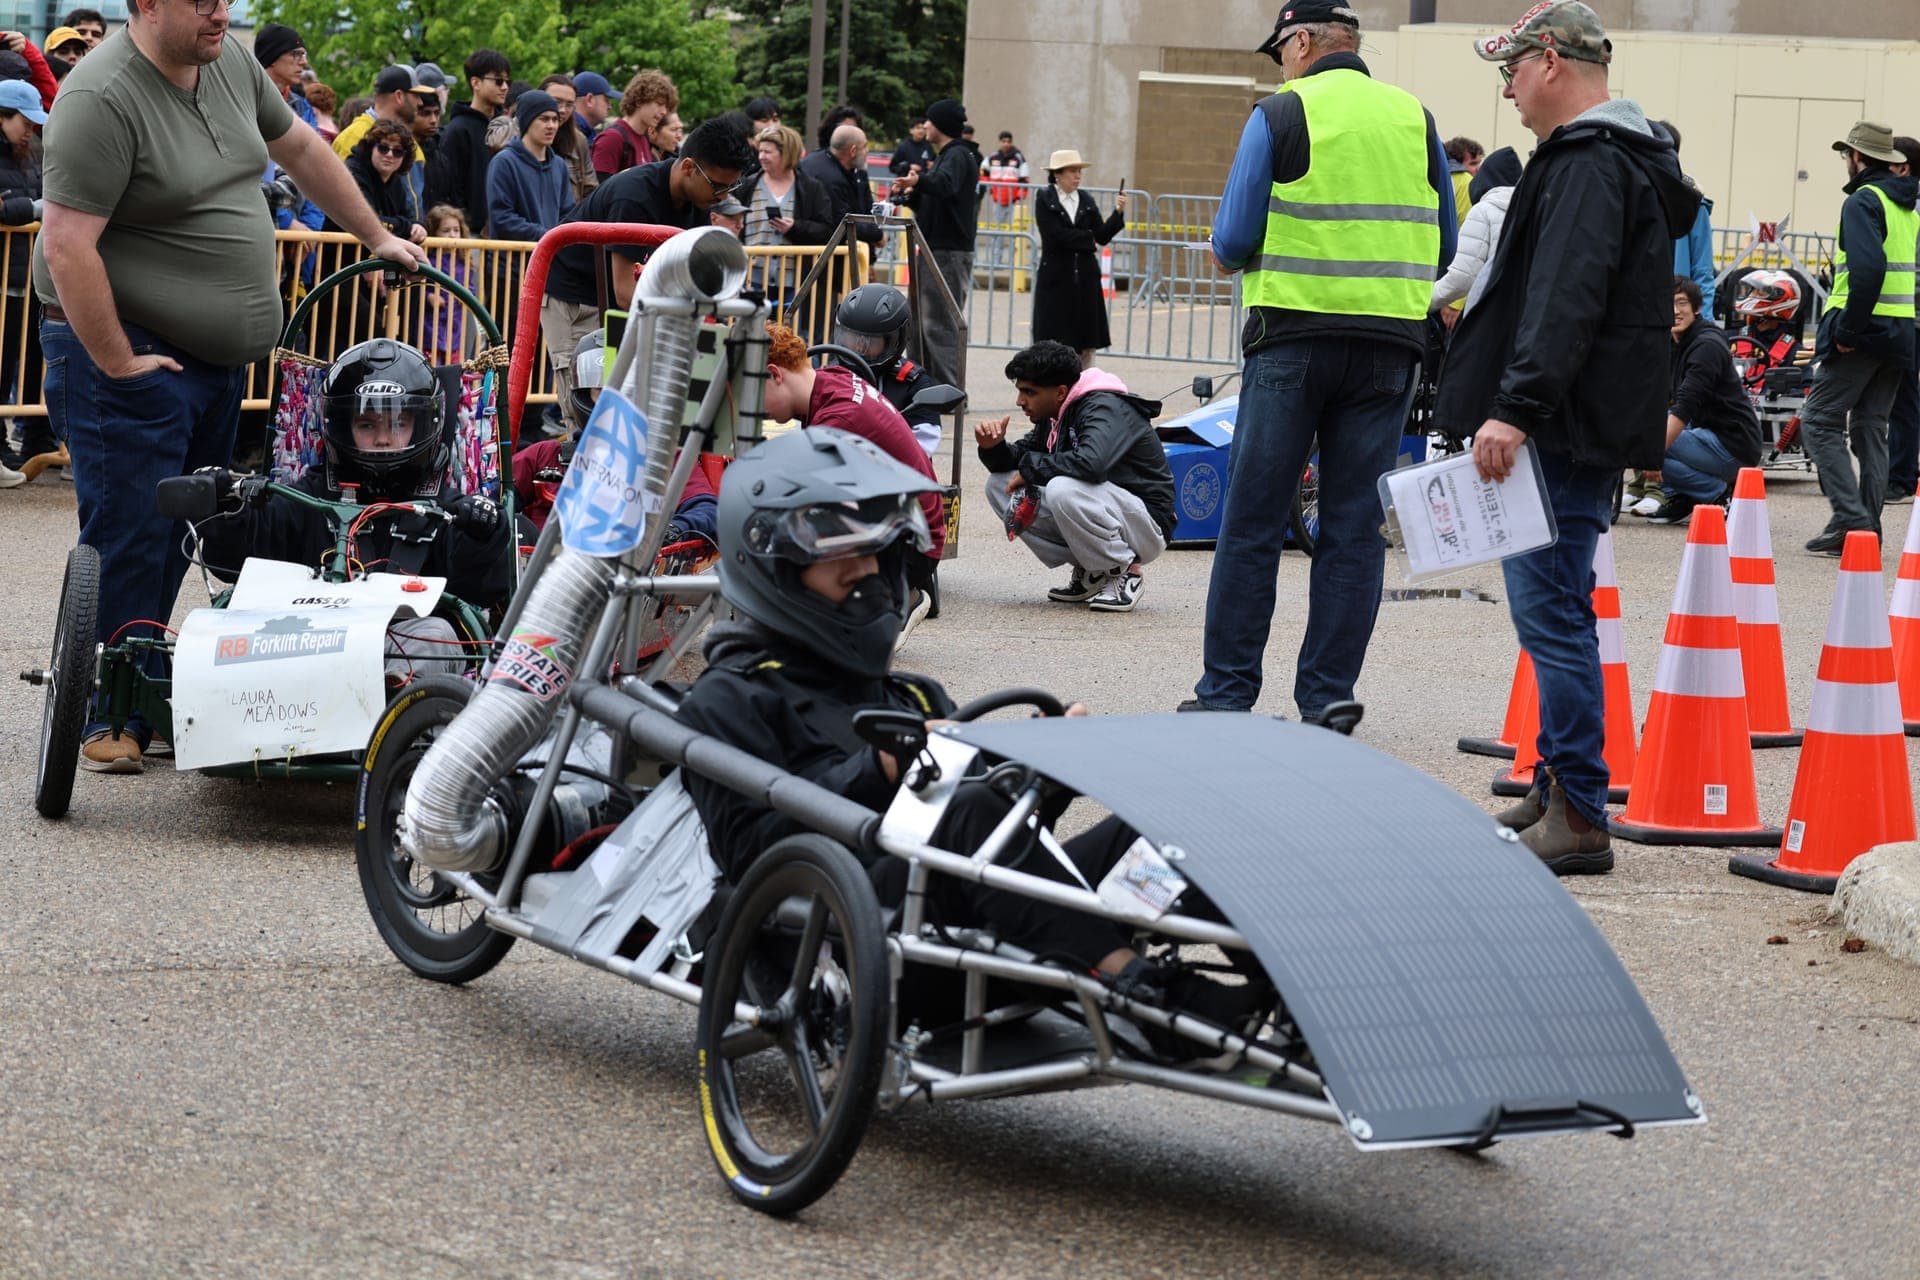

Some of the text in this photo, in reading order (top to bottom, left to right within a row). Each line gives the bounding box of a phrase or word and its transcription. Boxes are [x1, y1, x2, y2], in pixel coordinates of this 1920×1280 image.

[1758, 222, 1777, 243] N
[358, 382, 403, 396] HJC
[292, 597, 331, 605] CLASS
[219, 630, 343, 659] RB Forklift Repair
[231, 689, 275, 706] LAURA
[243, 701, 318, 723] MEADOWS
